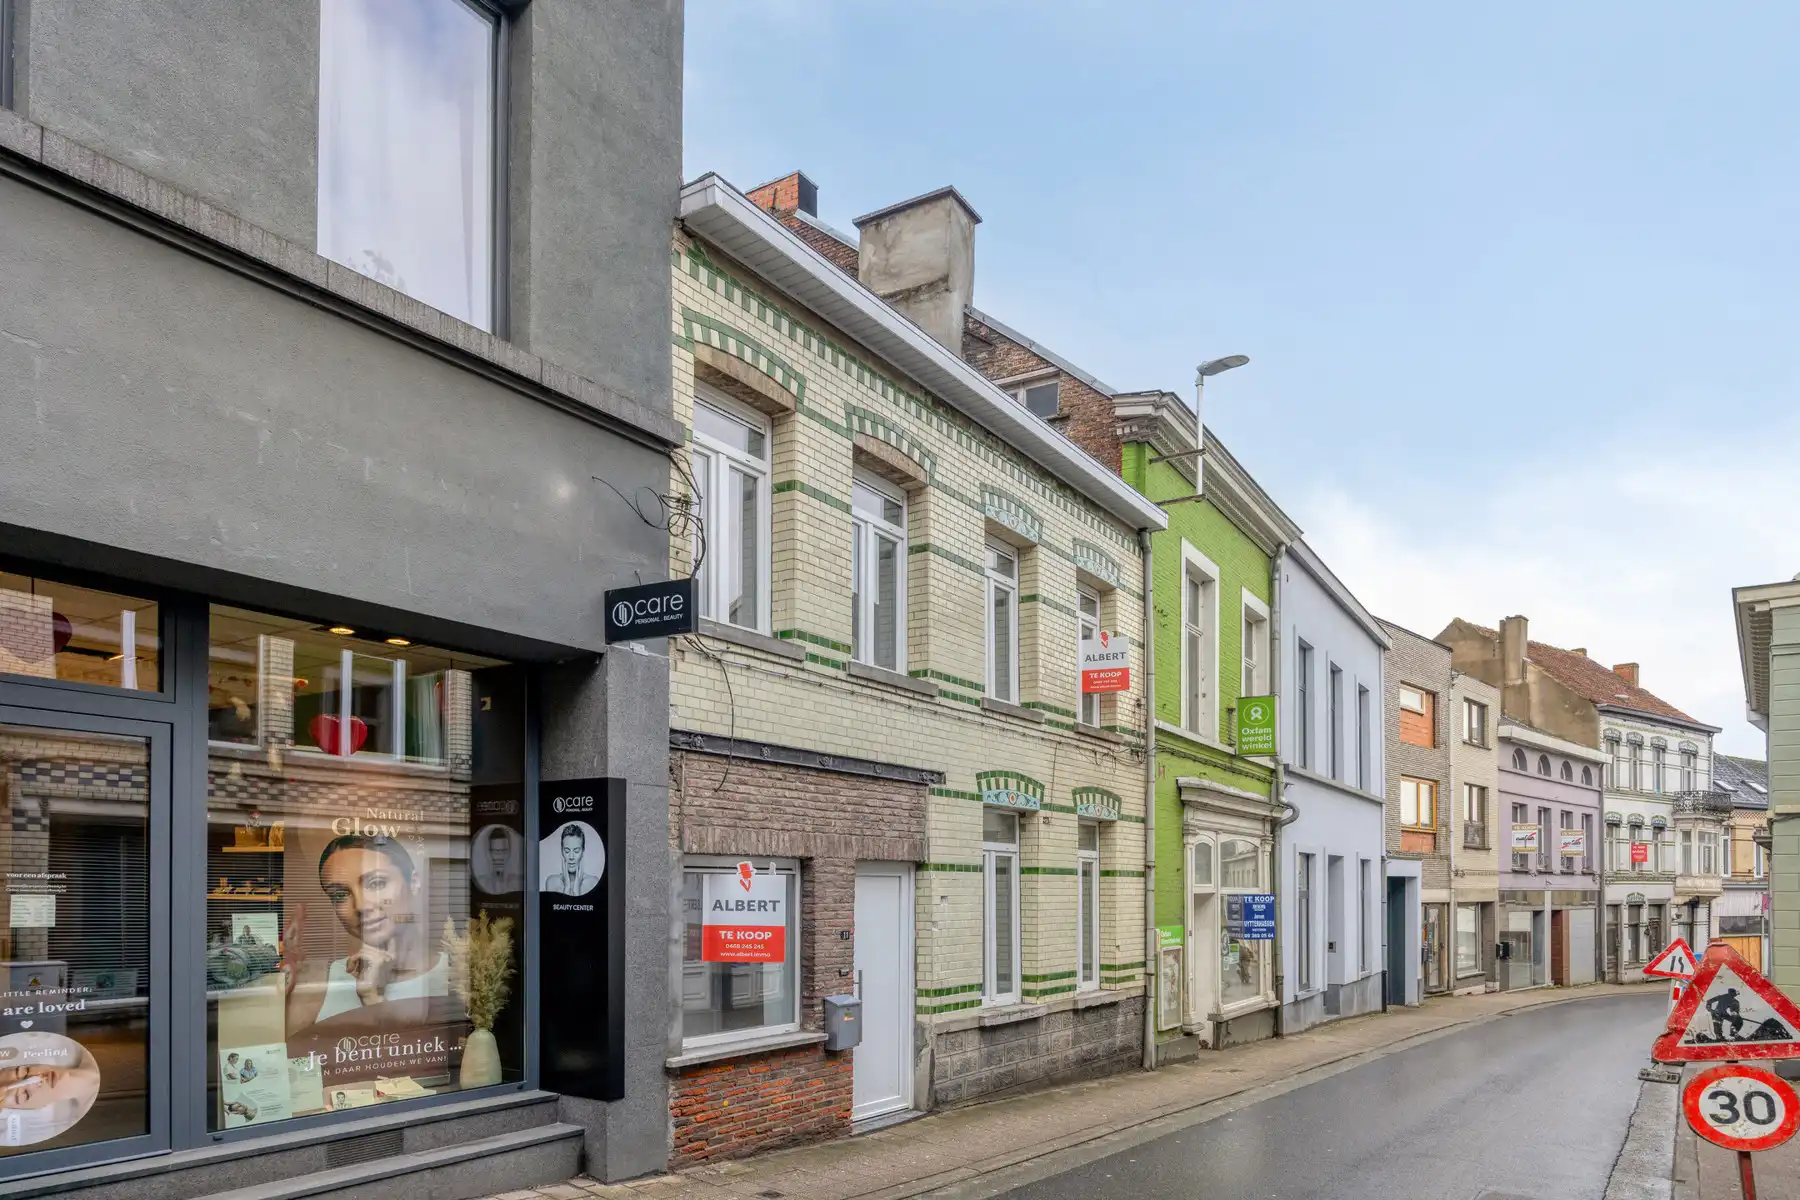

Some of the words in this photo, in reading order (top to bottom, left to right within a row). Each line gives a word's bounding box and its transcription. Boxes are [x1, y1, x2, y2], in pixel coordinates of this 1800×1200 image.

[633, 594, 684, 616] care
[634, 617, 661, 625] PERSONAL
[663, 613, 684, 621] BEAUTY
[1084, 651, 1127, 663] ALBERT
[1241, 734, 1272, 742] wereld
[1241, 742, 1272, 750] winkel
[565, 796, 594, 807] care
[366, 808, 425, 822] Natural
[331, 817, 400, 838] Glow
[712, 899, 780, 912] ALBERT
[1254, 895, 1275, 903] KOOP
[719, 930, 734, 940] TE
[736, 931, 773, 941] KOOP
[0, 990, 31, 998] ITTLE
[35, 986, 93, 996] REMINDER:
[3, 1005, 34, 1016] are
[38, 998, 87, 1014] loved
[358, 1033, 400, 1047] care
[304, 1051, 328, 1071] Je
[335, 1045, 382, 1064] bent
[388, 1036, 445, 1056] uniek
[335, 1066, 361, 1075] DAAR
[365, 1060, 406, 1071] HOUDEN
[425, 1055, 447, 1063] VAN!
[1707, 1090, 1776, 1126] 30
